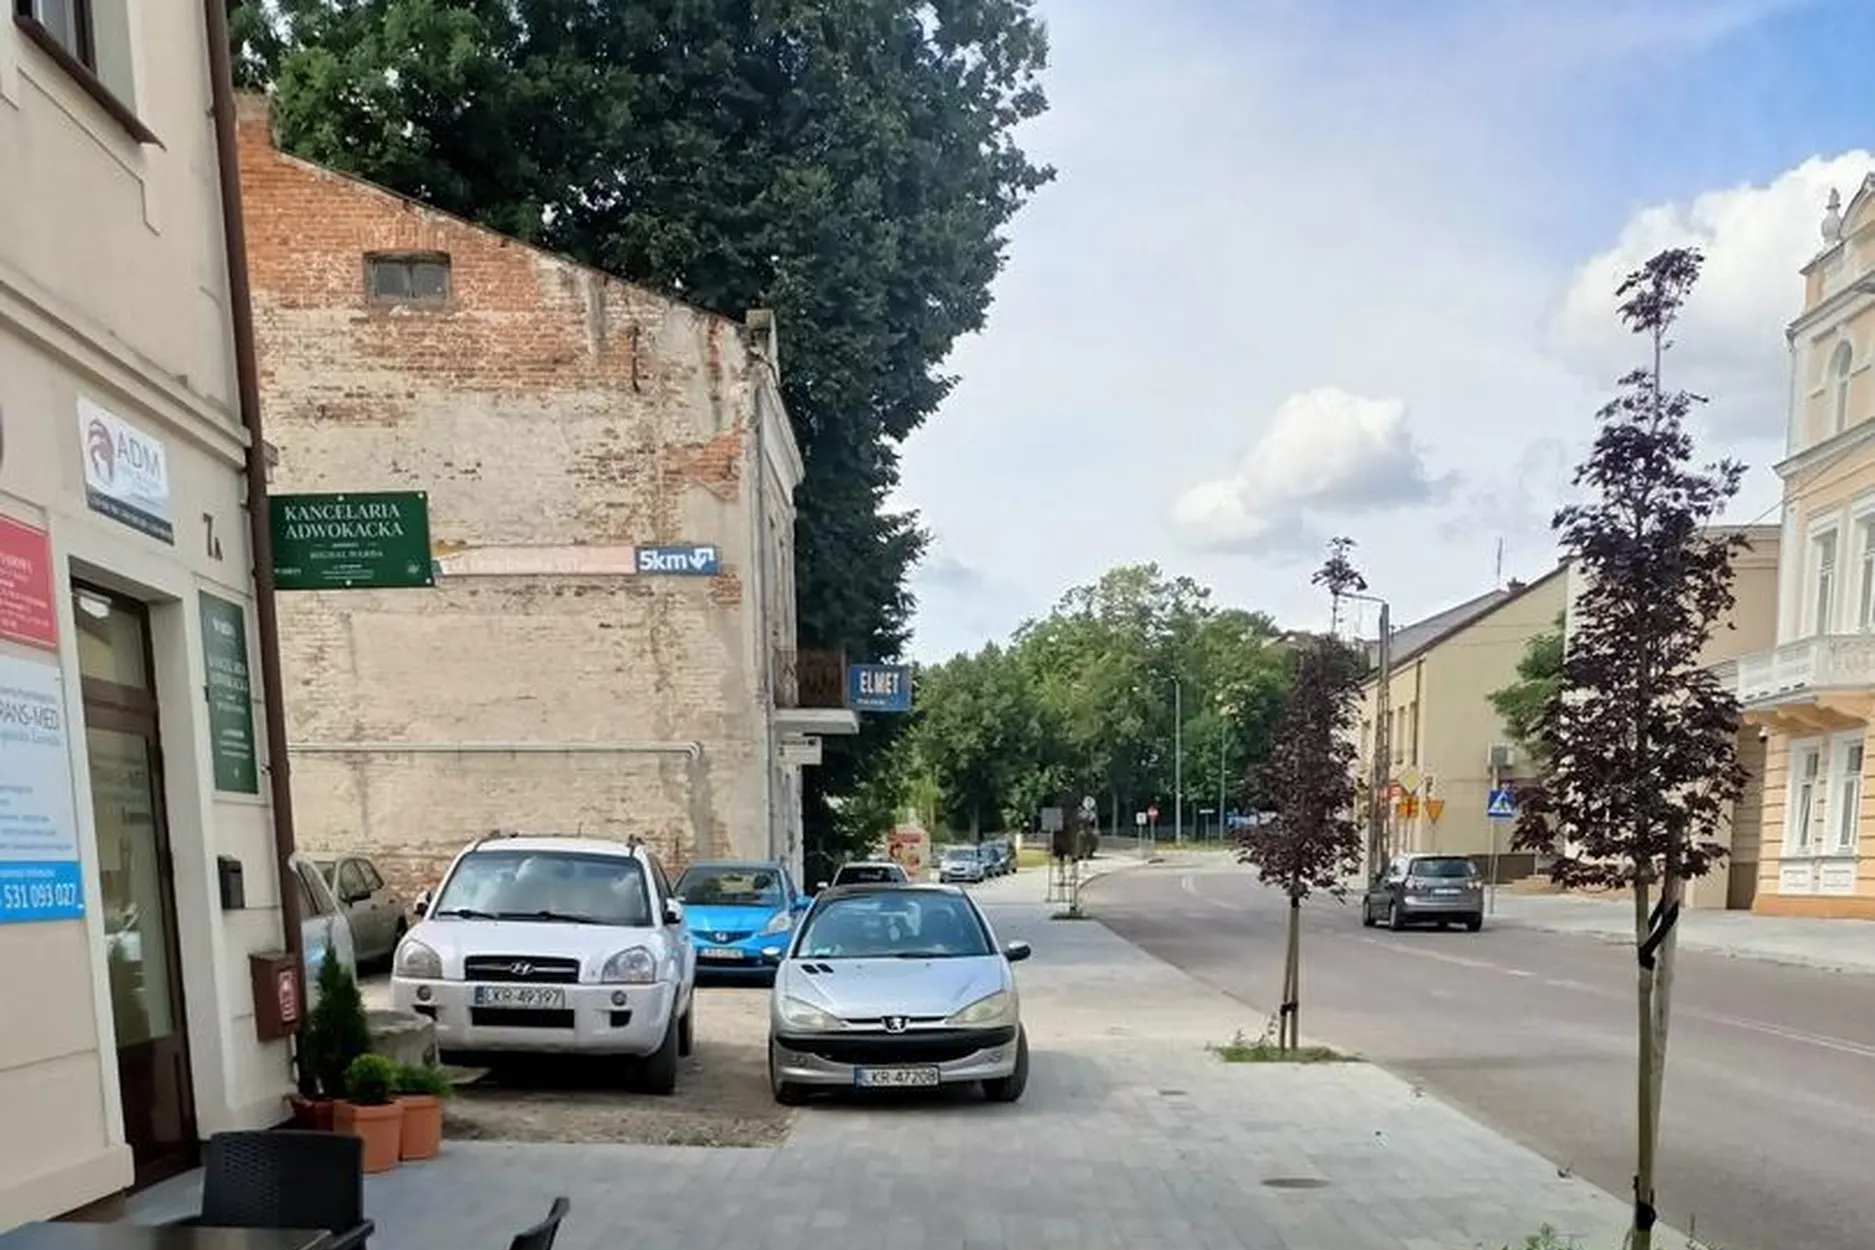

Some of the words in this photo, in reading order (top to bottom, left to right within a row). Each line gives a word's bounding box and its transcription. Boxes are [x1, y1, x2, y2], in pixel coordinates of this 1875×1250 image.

[117, 430, 161, 479] ADM
[284, 504, 401, 521] KANCELARIA
[285, 522, 405, 539] ADWOKACKA
[639, 549, 687, 571] 5km
[860, 670, 899, 694] ELMET
[4, 884, 28, 908] 531
